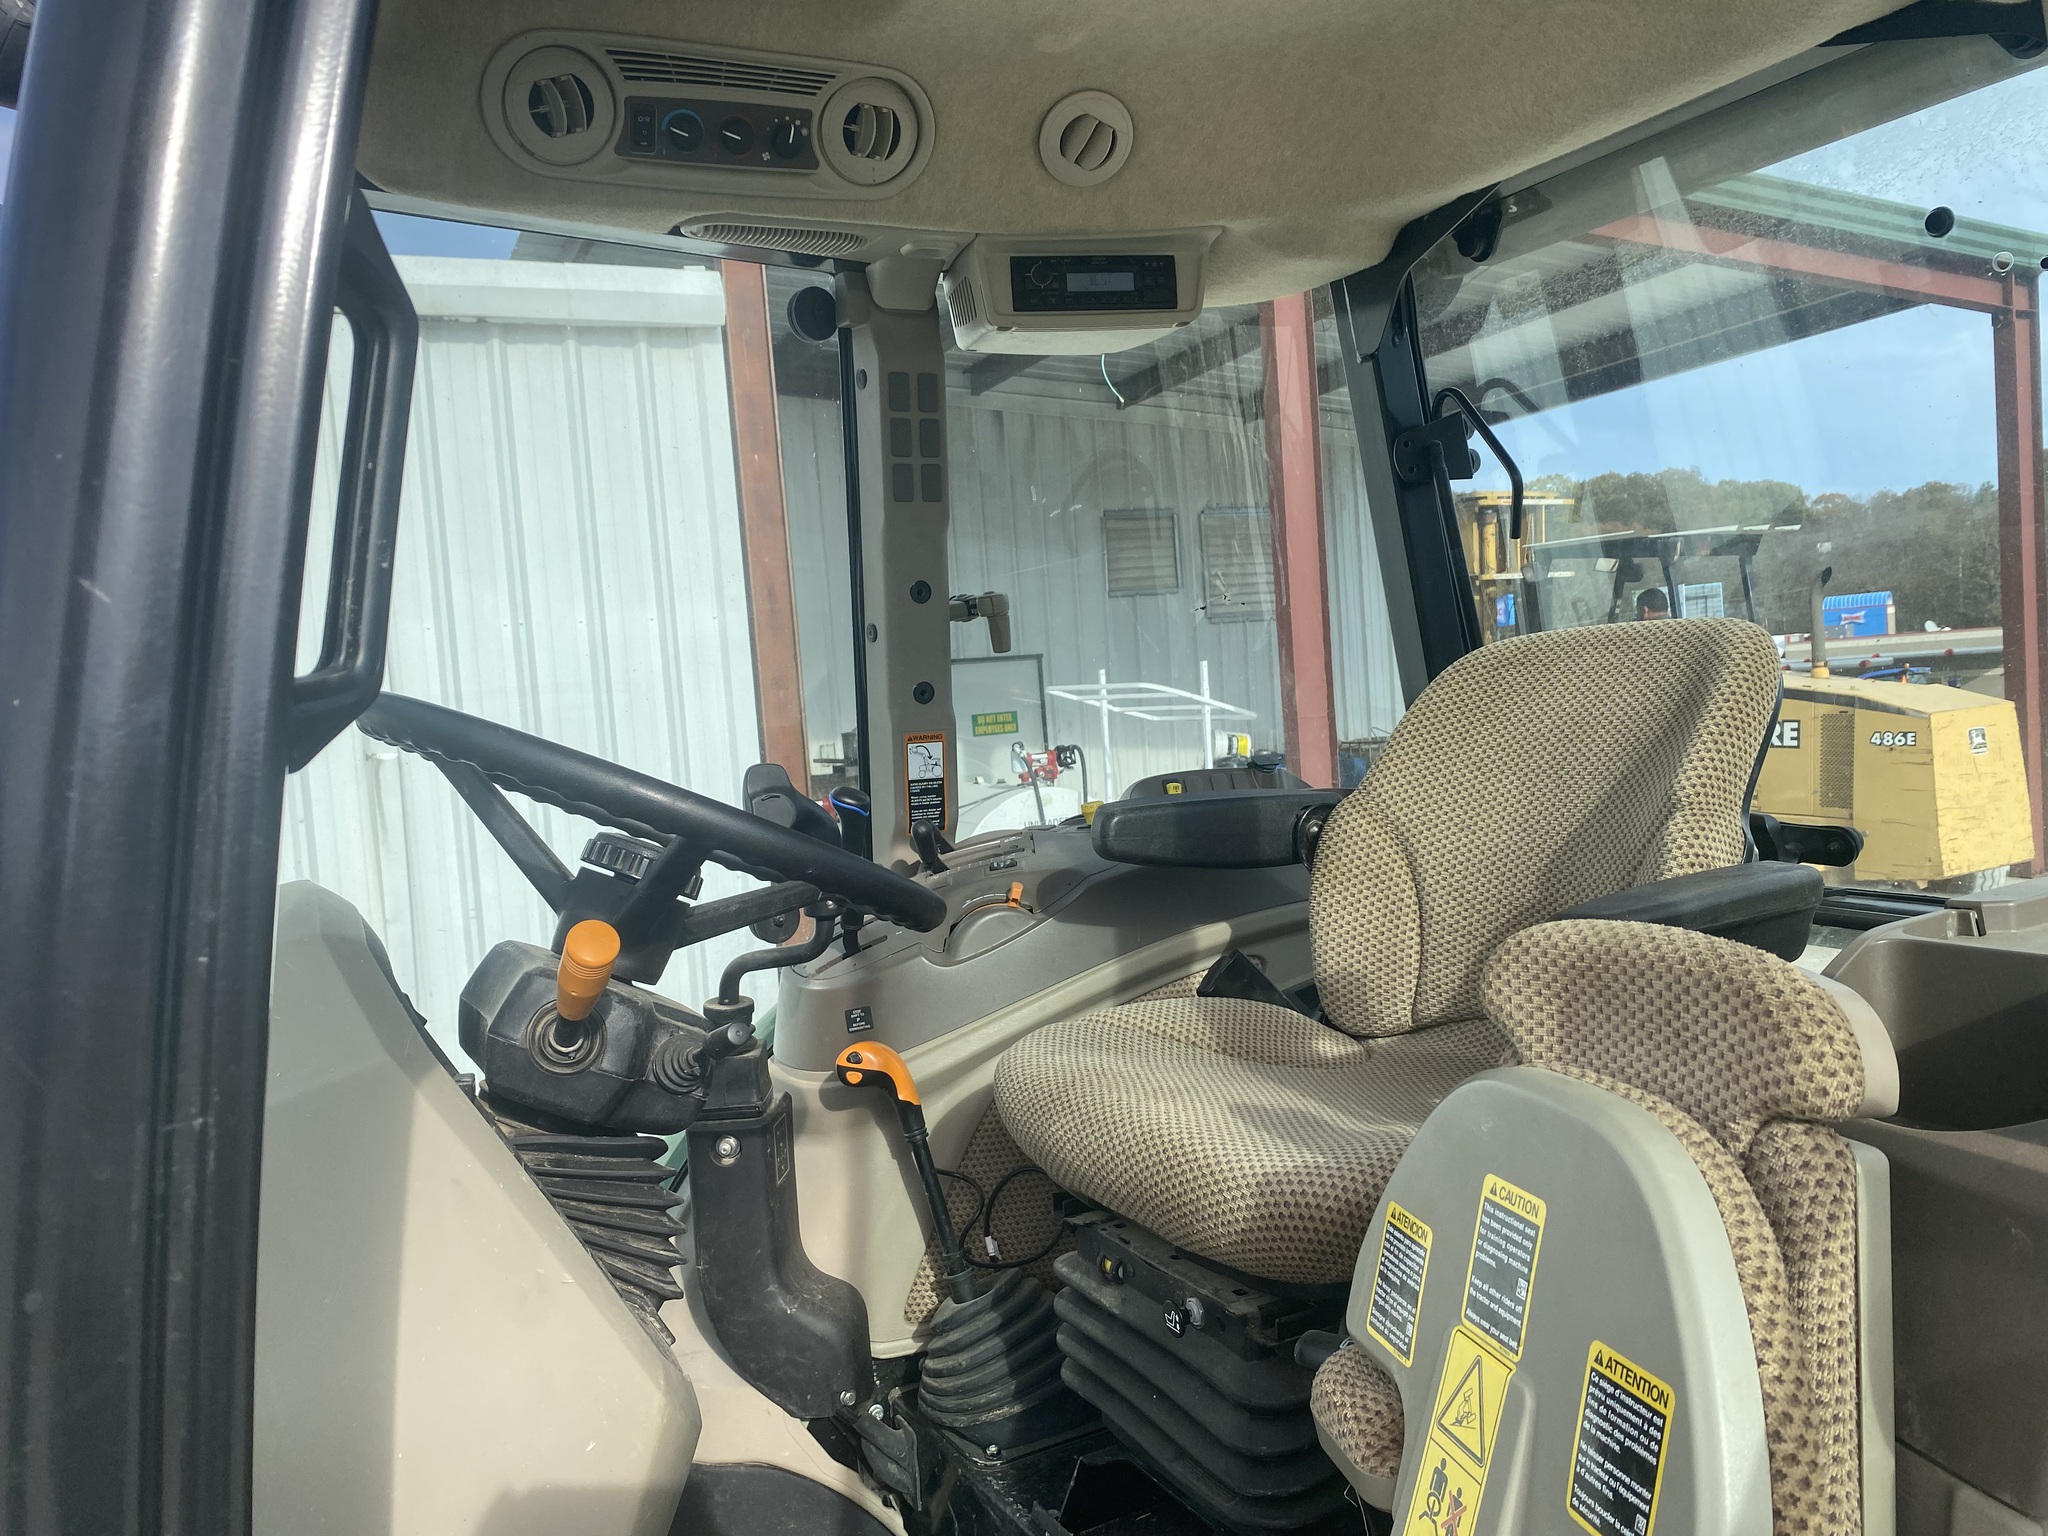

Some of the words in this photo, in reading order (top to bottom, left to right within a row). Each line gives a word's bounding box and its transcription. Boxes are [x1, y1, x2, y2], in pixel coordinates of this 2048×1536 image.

[912, 734, 943, 742] WARNING
[975, 724, 1003, 735] EMPLOYEES
[1870, 731, 1917, 747] 486E
[1484, 1202, 1494, 1214] This
[1494, 1208, 1524, 1230] instructional
[1525, 1225, 1536, 1237] seat
[1499, 1186, 1540, 1219] CAUTION
[1397, 1211, 1428, 1243] ATENCION
[1482, 1214, 1490, 1225] has
[1490, 1219, 1502, 1231] been
[1501, 1226, 1522, 1244] provided
[1522, 1238, 1533, 1251] only
[1476, 1250, 1497, 1269] problems.
[1478, 1238, 1483, 1246] or
[1483, 1240, 1508, 1264] diagnosing
[1508, 1257, 1528, 1275] machine
[1487, 1230, 1506, 1249] training
[1506, 1242, 1531, 1264] operators
[1471, 1274, 1483, 1289] Keep
[1489, 1286, 1501, 1300] other
[1501, 1294, 1515, 1310] riders
[1476, 1292, 1490, 1306] tractor
[1490, 1301, 1498, 1312] and
[1466, 1307, 1480, 1325] Always
[1480, 1318, 1490, 1330] wear
[1490, 1326, 1500, 1338] your
[1500, 1332, 1509, 1344] seat
[1591, 1371, 1599, 1384] Ce
[1599, 1378, 1615, 1397] siège
[1614, 1388, 1652, 1421] d'instructeur
[1653, 1414, 1663, 1428] est
[1605, 1356, 1669, 1409] ATTENTION
[1587, 1395, 1598, 1410] fins
[1599, 1404, 1607, 1416] de
[1608, 1409, 1639, 1438] formation
[1639, 1433, 1649, 1446] ou
[1650, 1439, 1659, 1453] de
[1589, 1384, 1605, 1403] prévu
[1606, 1395, 1643, 1429] uniquement
[1643, 1420, 1648, 1431] à
[1649, 1425, 1662, 1441] des
[1583, 1419, 1590, 1431] de
[1590, 1424, 1596, 1435] la
[1596, 1429, 1621, 1455] machine.
[1585, 1408, 1613, 1436] diagnostic
[1613, 1428, 1624, 1443] des
[1624, 1436, 1657, 1469] problèmes
[1576, 1463, 1580, 1473] à
[1580, 1466, 1602, 1491] d'autres
[1580, 1440, 1587, 1452] Ne
[1587, 1446, 1604, 1465] laisser
[1604, 1459, 1630, 1488] personne
[1630, 1480, 1651, 1502] monter
[1586, 1457, 1591, 1468] le
[1590, 1462, 1609, 1483] tracteur
[1608, 1477, 1616, 1489] ou
[1616, 1481, 1649, 1517] l'équipement
[1572, 1495, 1579, 1508] de
[1579, 1502, 1601, 1528] sécurité.
[1574, 1484, 1595, 1510] Toujours
[1595, 1502, 1614, 1526] boucler
[1615, 1519, 1621, 1530] la
